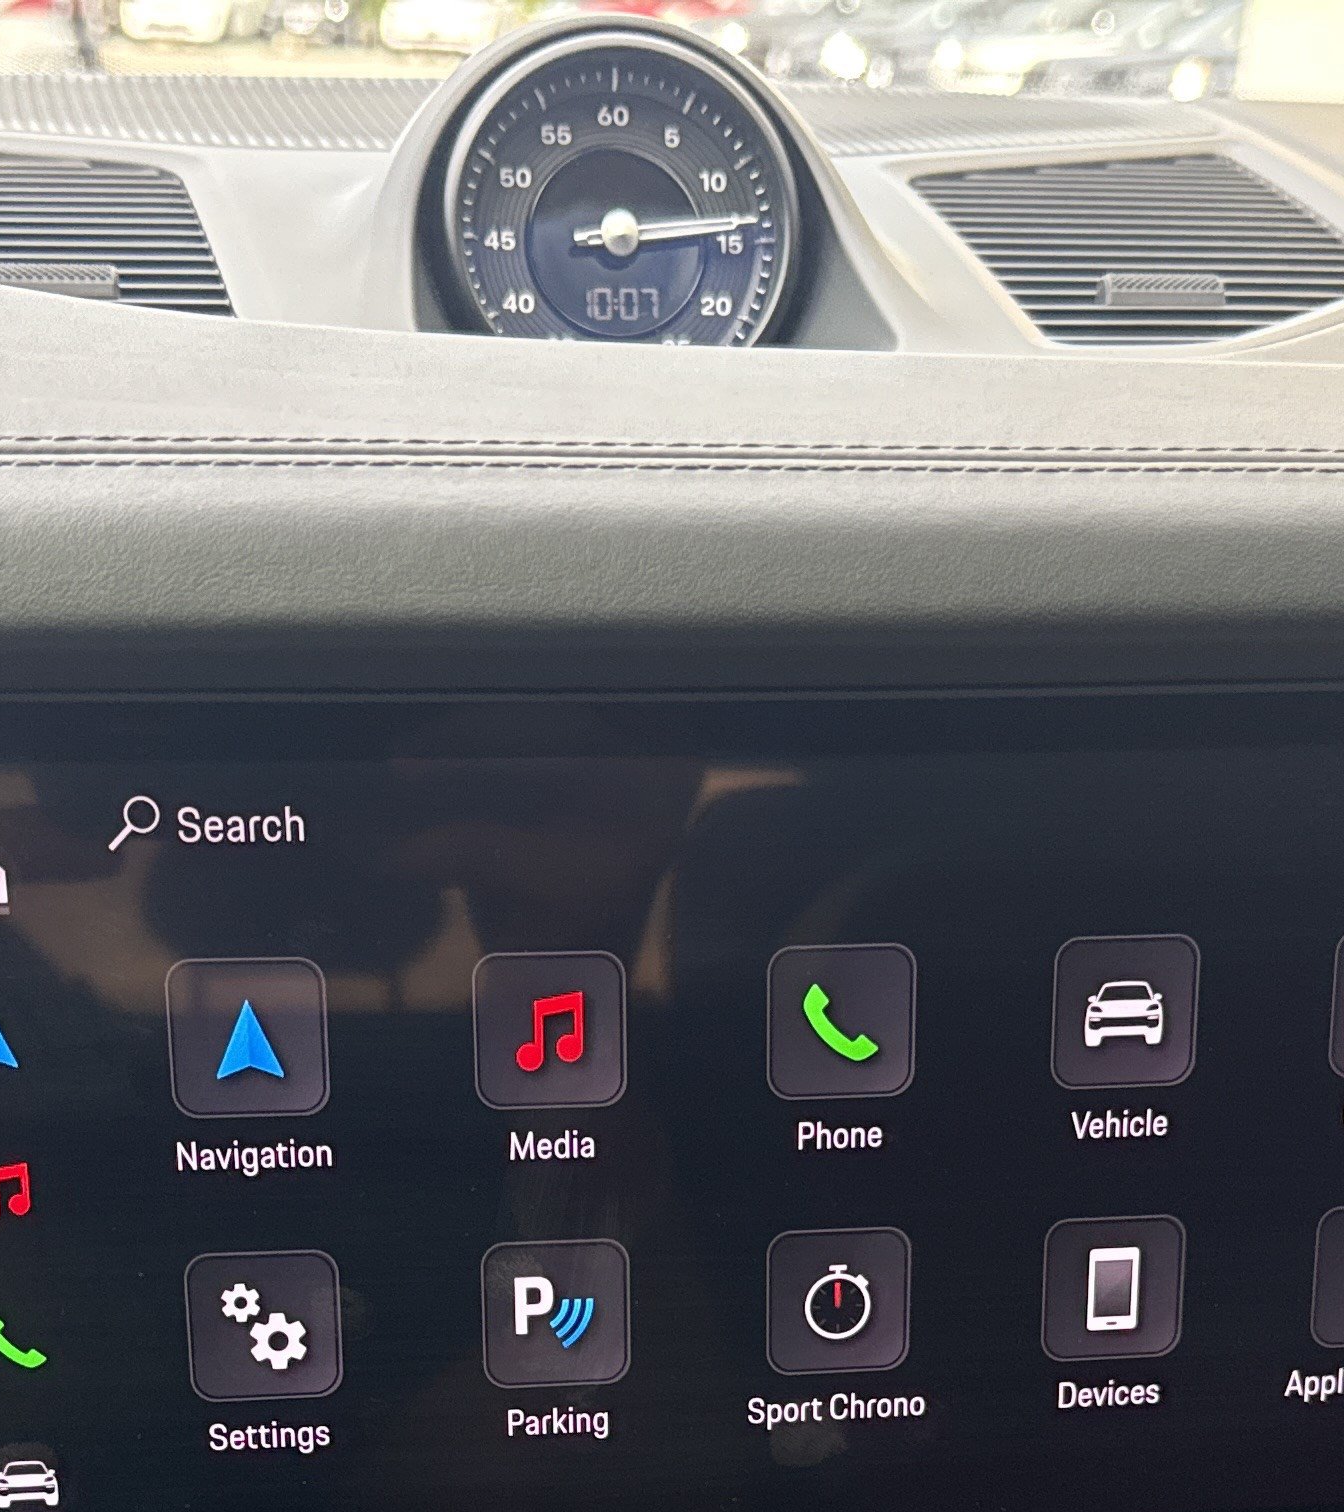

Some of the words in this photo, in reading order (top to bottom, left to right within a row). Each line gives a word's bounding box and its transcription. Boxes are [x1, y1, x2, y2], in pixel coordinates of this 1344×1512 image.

[597, 107, 629, 126] 60
[541, 126, 572, 145] 55
[664, 128, 681, 148] 5
[500, 168, 532, 188] 50
[700, 172, 728, 193] 10
[484, 230, 516, 250] 45
[717, 233, 743, 254] 15
[503, 294, 535, 314] 40
[586, 287, 660, 321] 10:07
[701, 297, 732, 316] 20
[177, 806, 306, 844] Search
[798, 1121, 883, 1150] Phone
[1072, 1109, 1168, 1140] Vehicle
[176, 1140, 333, 1177] Navigation
[509, 1131, 596, 1161] Media
[514, 1275, 553, 1336] P
[1058, 1380, 1160, 1409] Devices
[507, 1408, 610, 1440] Parking
[748, 1397, 823, 1430] Sport
[830, 1392, 926, 1422] Chrono
[209, 1422, 331, 1453] Settings
